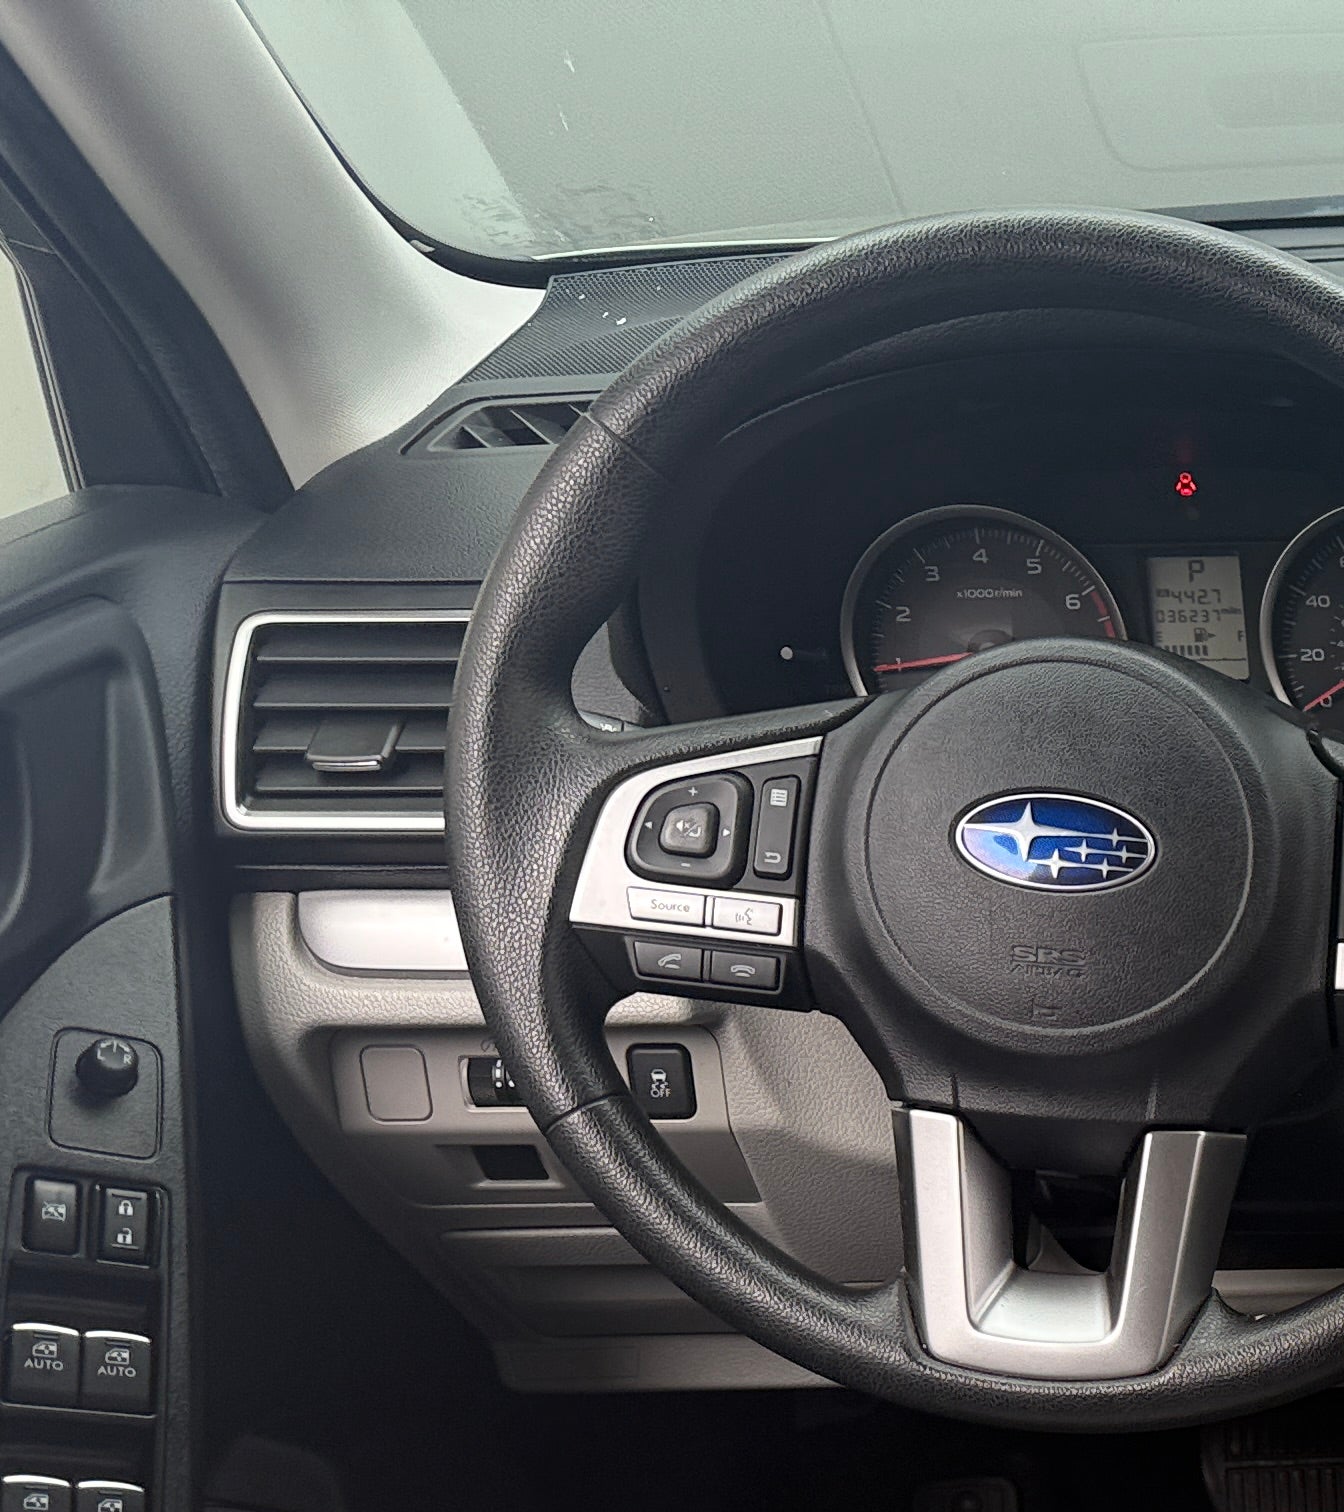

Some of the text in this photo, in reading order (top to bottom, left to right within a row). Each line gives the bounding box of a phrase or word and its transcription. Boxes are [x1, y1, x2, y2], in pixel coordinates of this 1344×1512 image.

[972, 549, 989, 564] 4
[1026, 558, 1042, 574] 5
[1188, 560, 1204, 582] P
[925, 566, 940, 582] 3
[1065, 594, 1081, 610] 6
[1306, 595, 1330, 608] 40
[896, 606, 912, 622] 2
[1156, 610, 1221, 623] 036237
[1237, 630, 1244, 642] F
[1300, 648, 1324, 662] 20
[651, 899, 690, 913] Source
[1011, 944, 1086, 967] SRS
[124, 1054, 132, 1064] R
[650, 1088, 671, 1098] OFF
[24, 1358, 64, 1371] AUTO
[98, 1366, 136, 1378] AUTO
